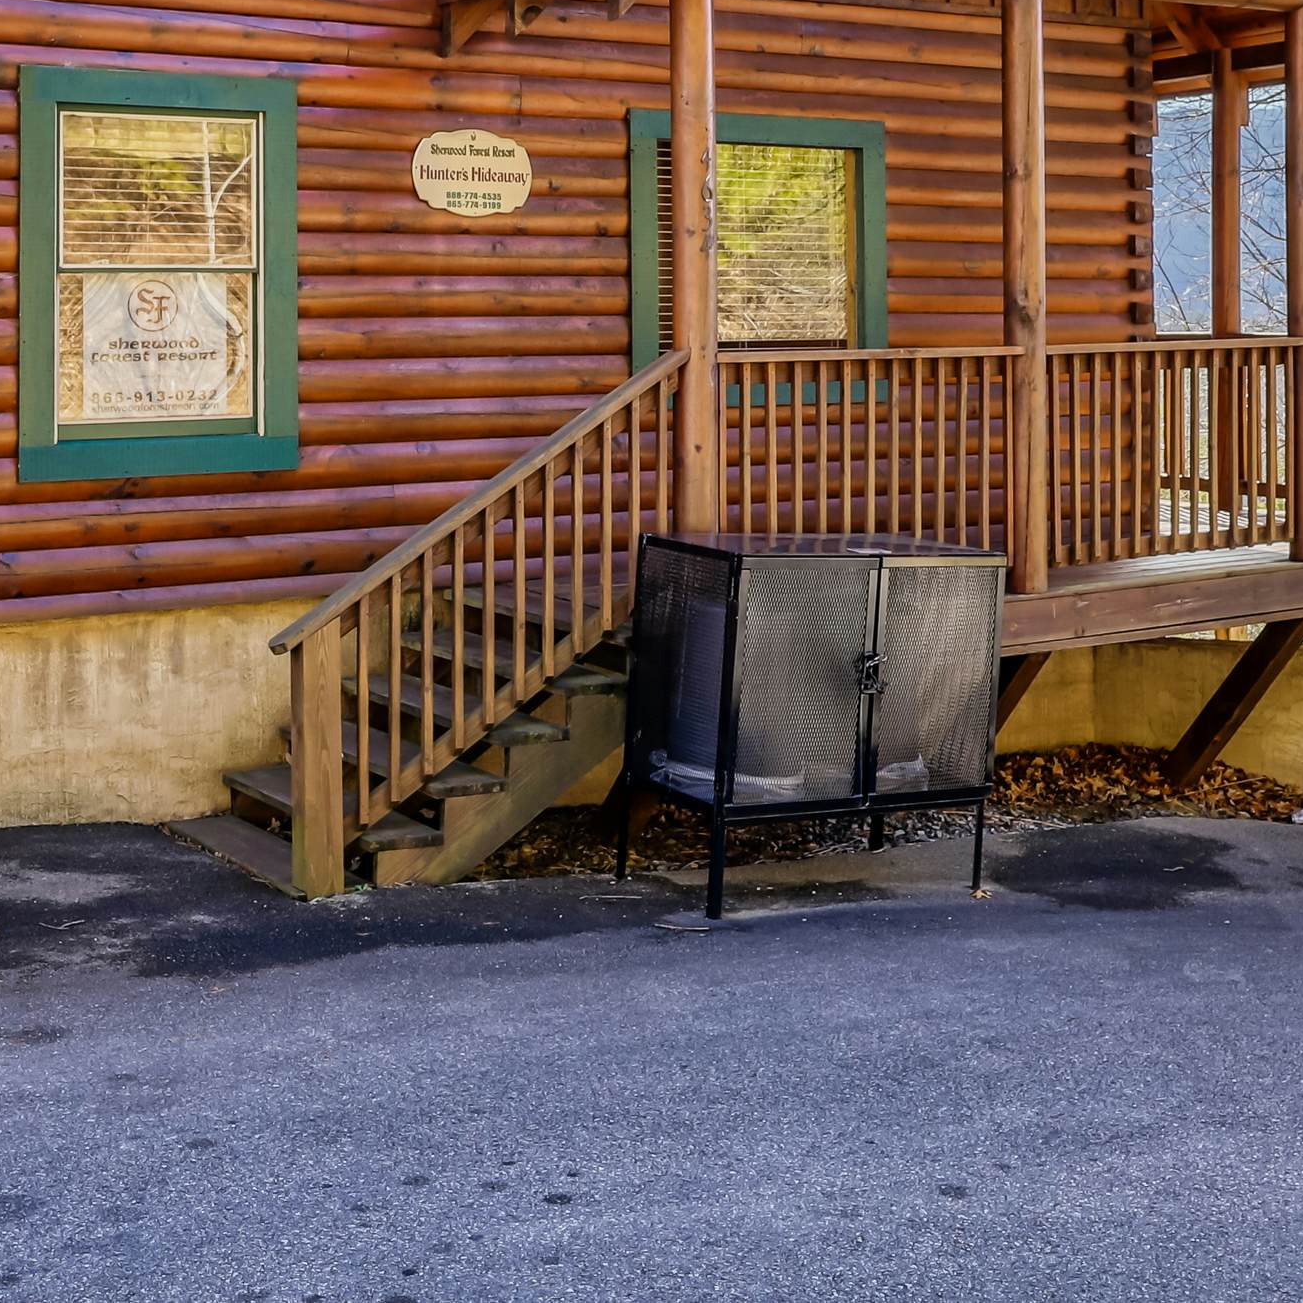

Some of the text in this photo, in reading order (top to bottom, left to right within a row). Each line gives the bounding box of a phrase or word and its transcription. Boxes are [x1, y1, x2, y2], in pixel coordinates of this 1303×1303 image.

[430, 144, 467, 156] Sherwood
[493, 145, 515, 158] Resort
[419, 164, 530, 186] Hunter's Hideaway
